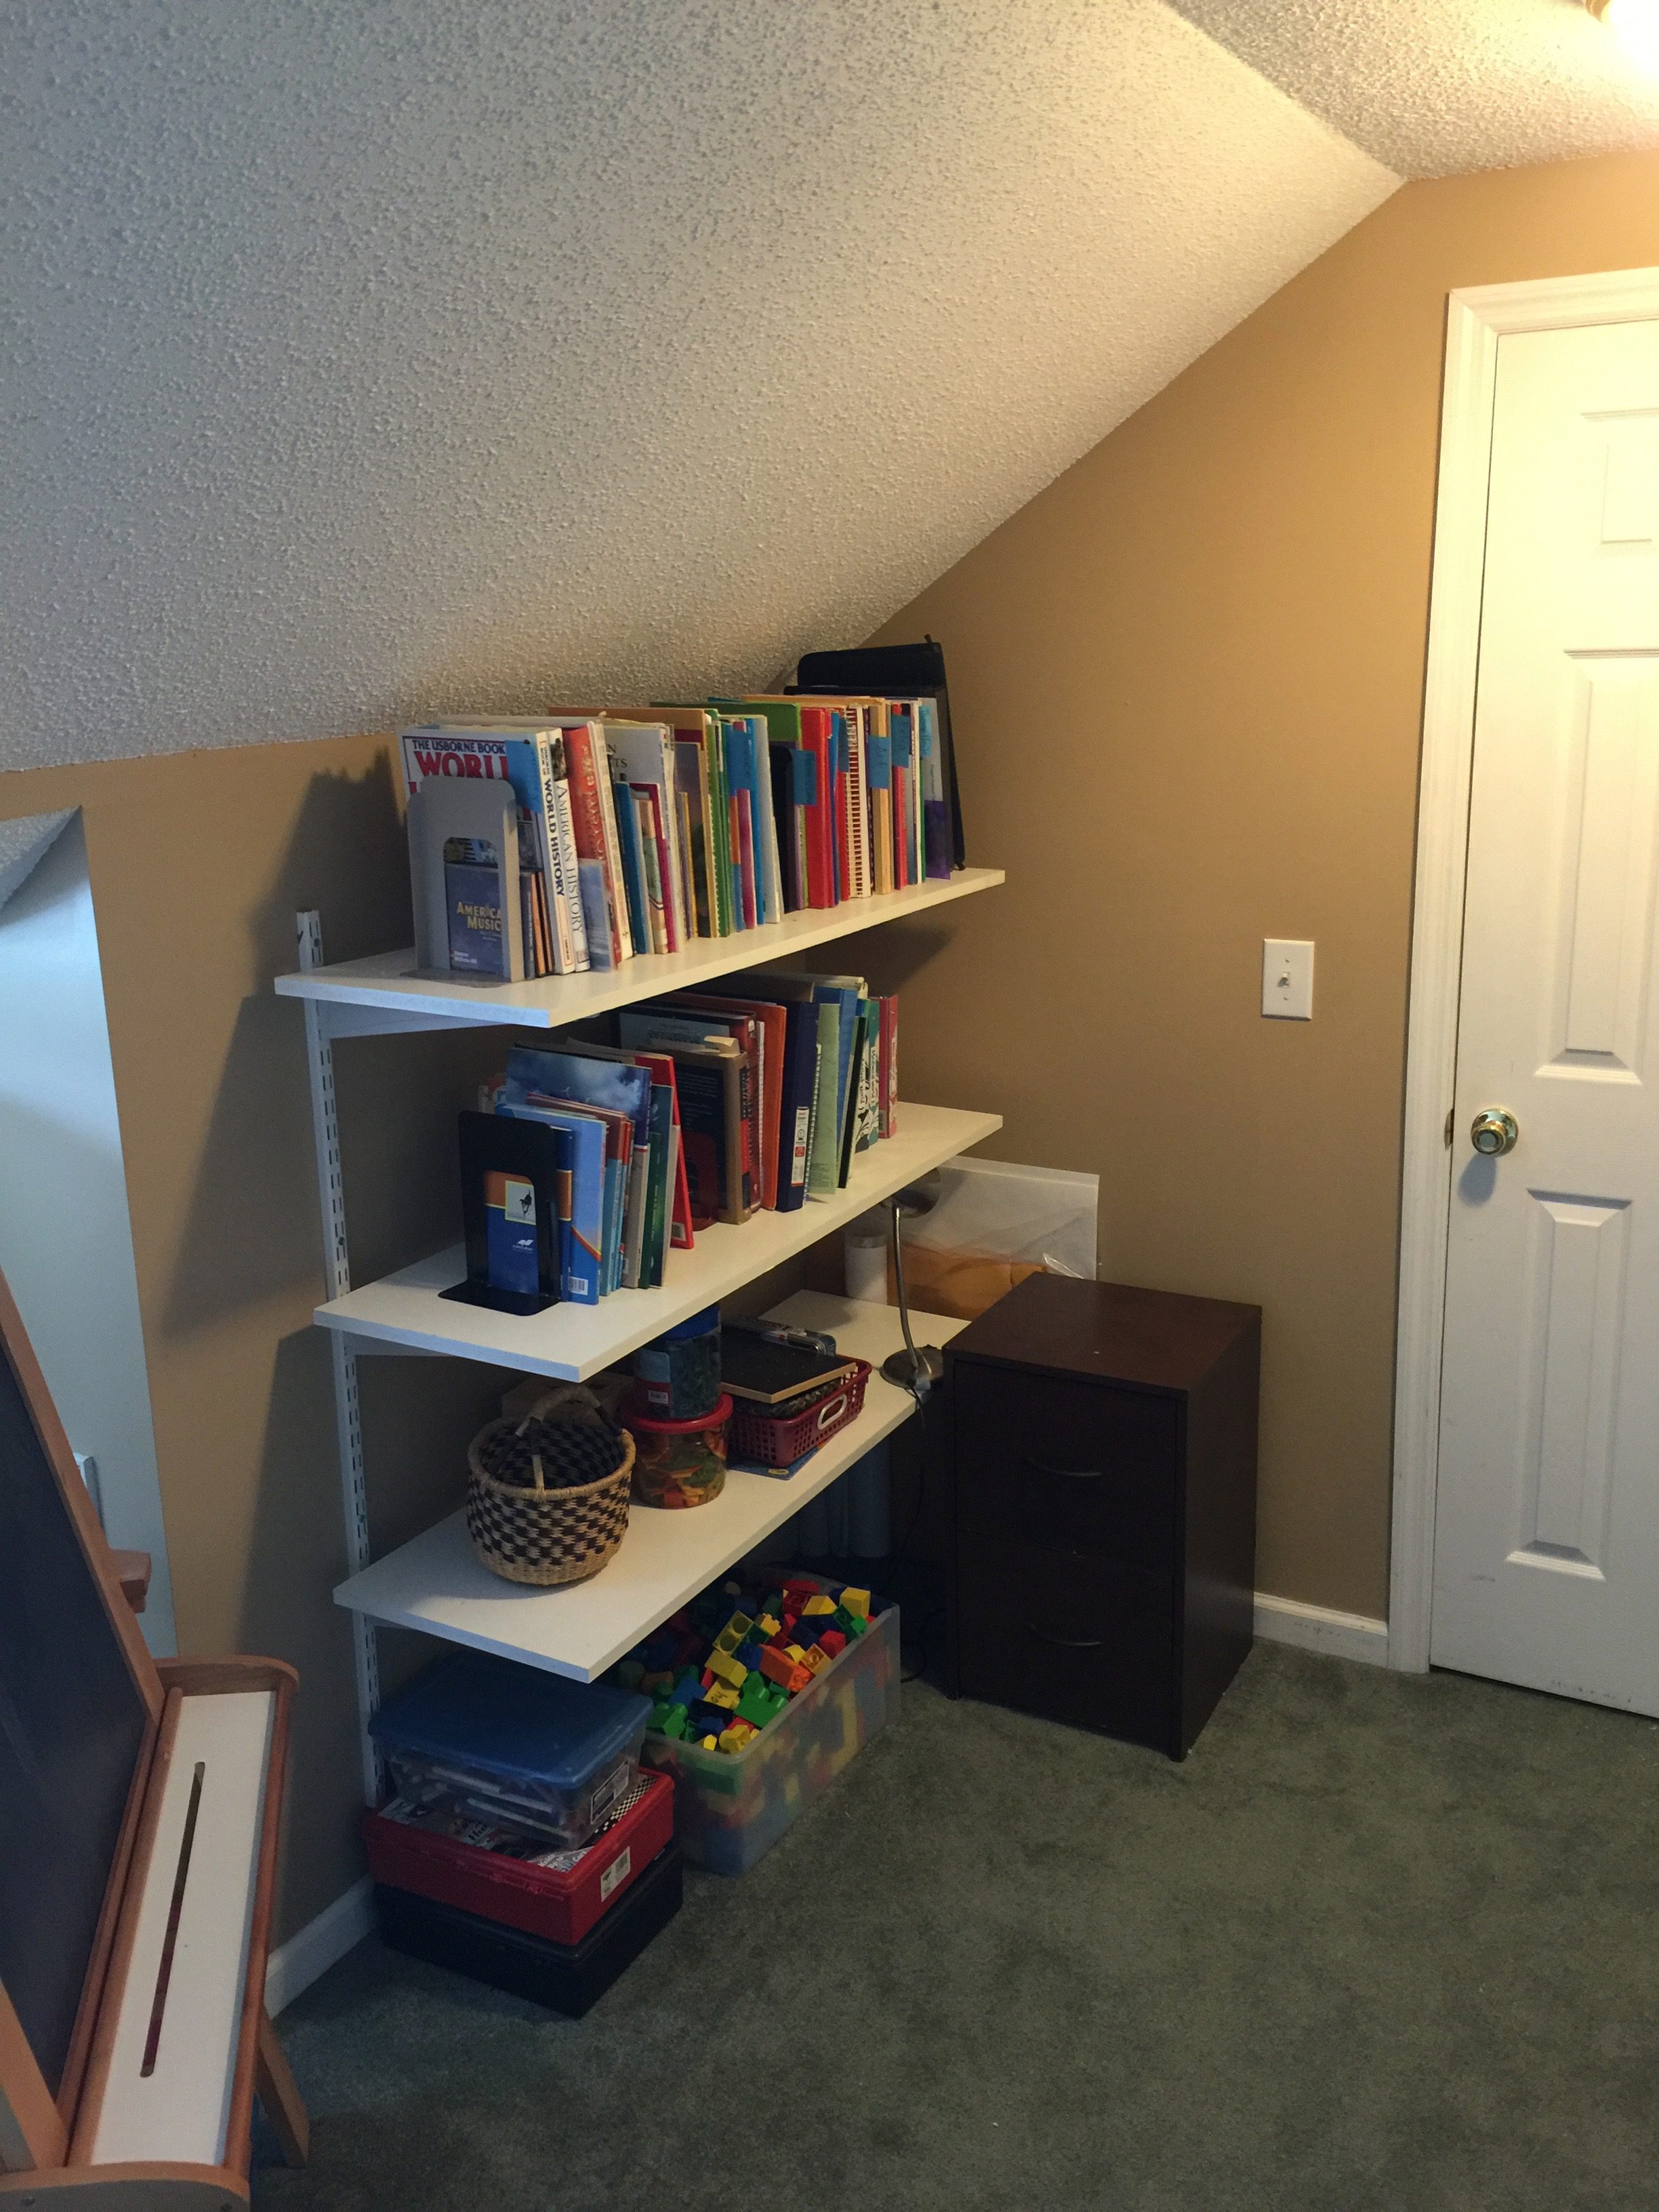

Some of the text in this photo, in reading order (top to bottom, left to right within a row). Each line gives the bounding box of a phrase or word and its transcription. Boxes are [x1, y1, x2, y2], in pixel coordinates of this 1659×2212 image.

[412, 739, 506, 754] THE USBORNE BOOK
[544, 778, 556, 834] WORLD
[550, 836, 565, 897] HISTORY
[556, 785, 573, 862] AMERICAN
[566, 867, 583, 933] HISTORY
